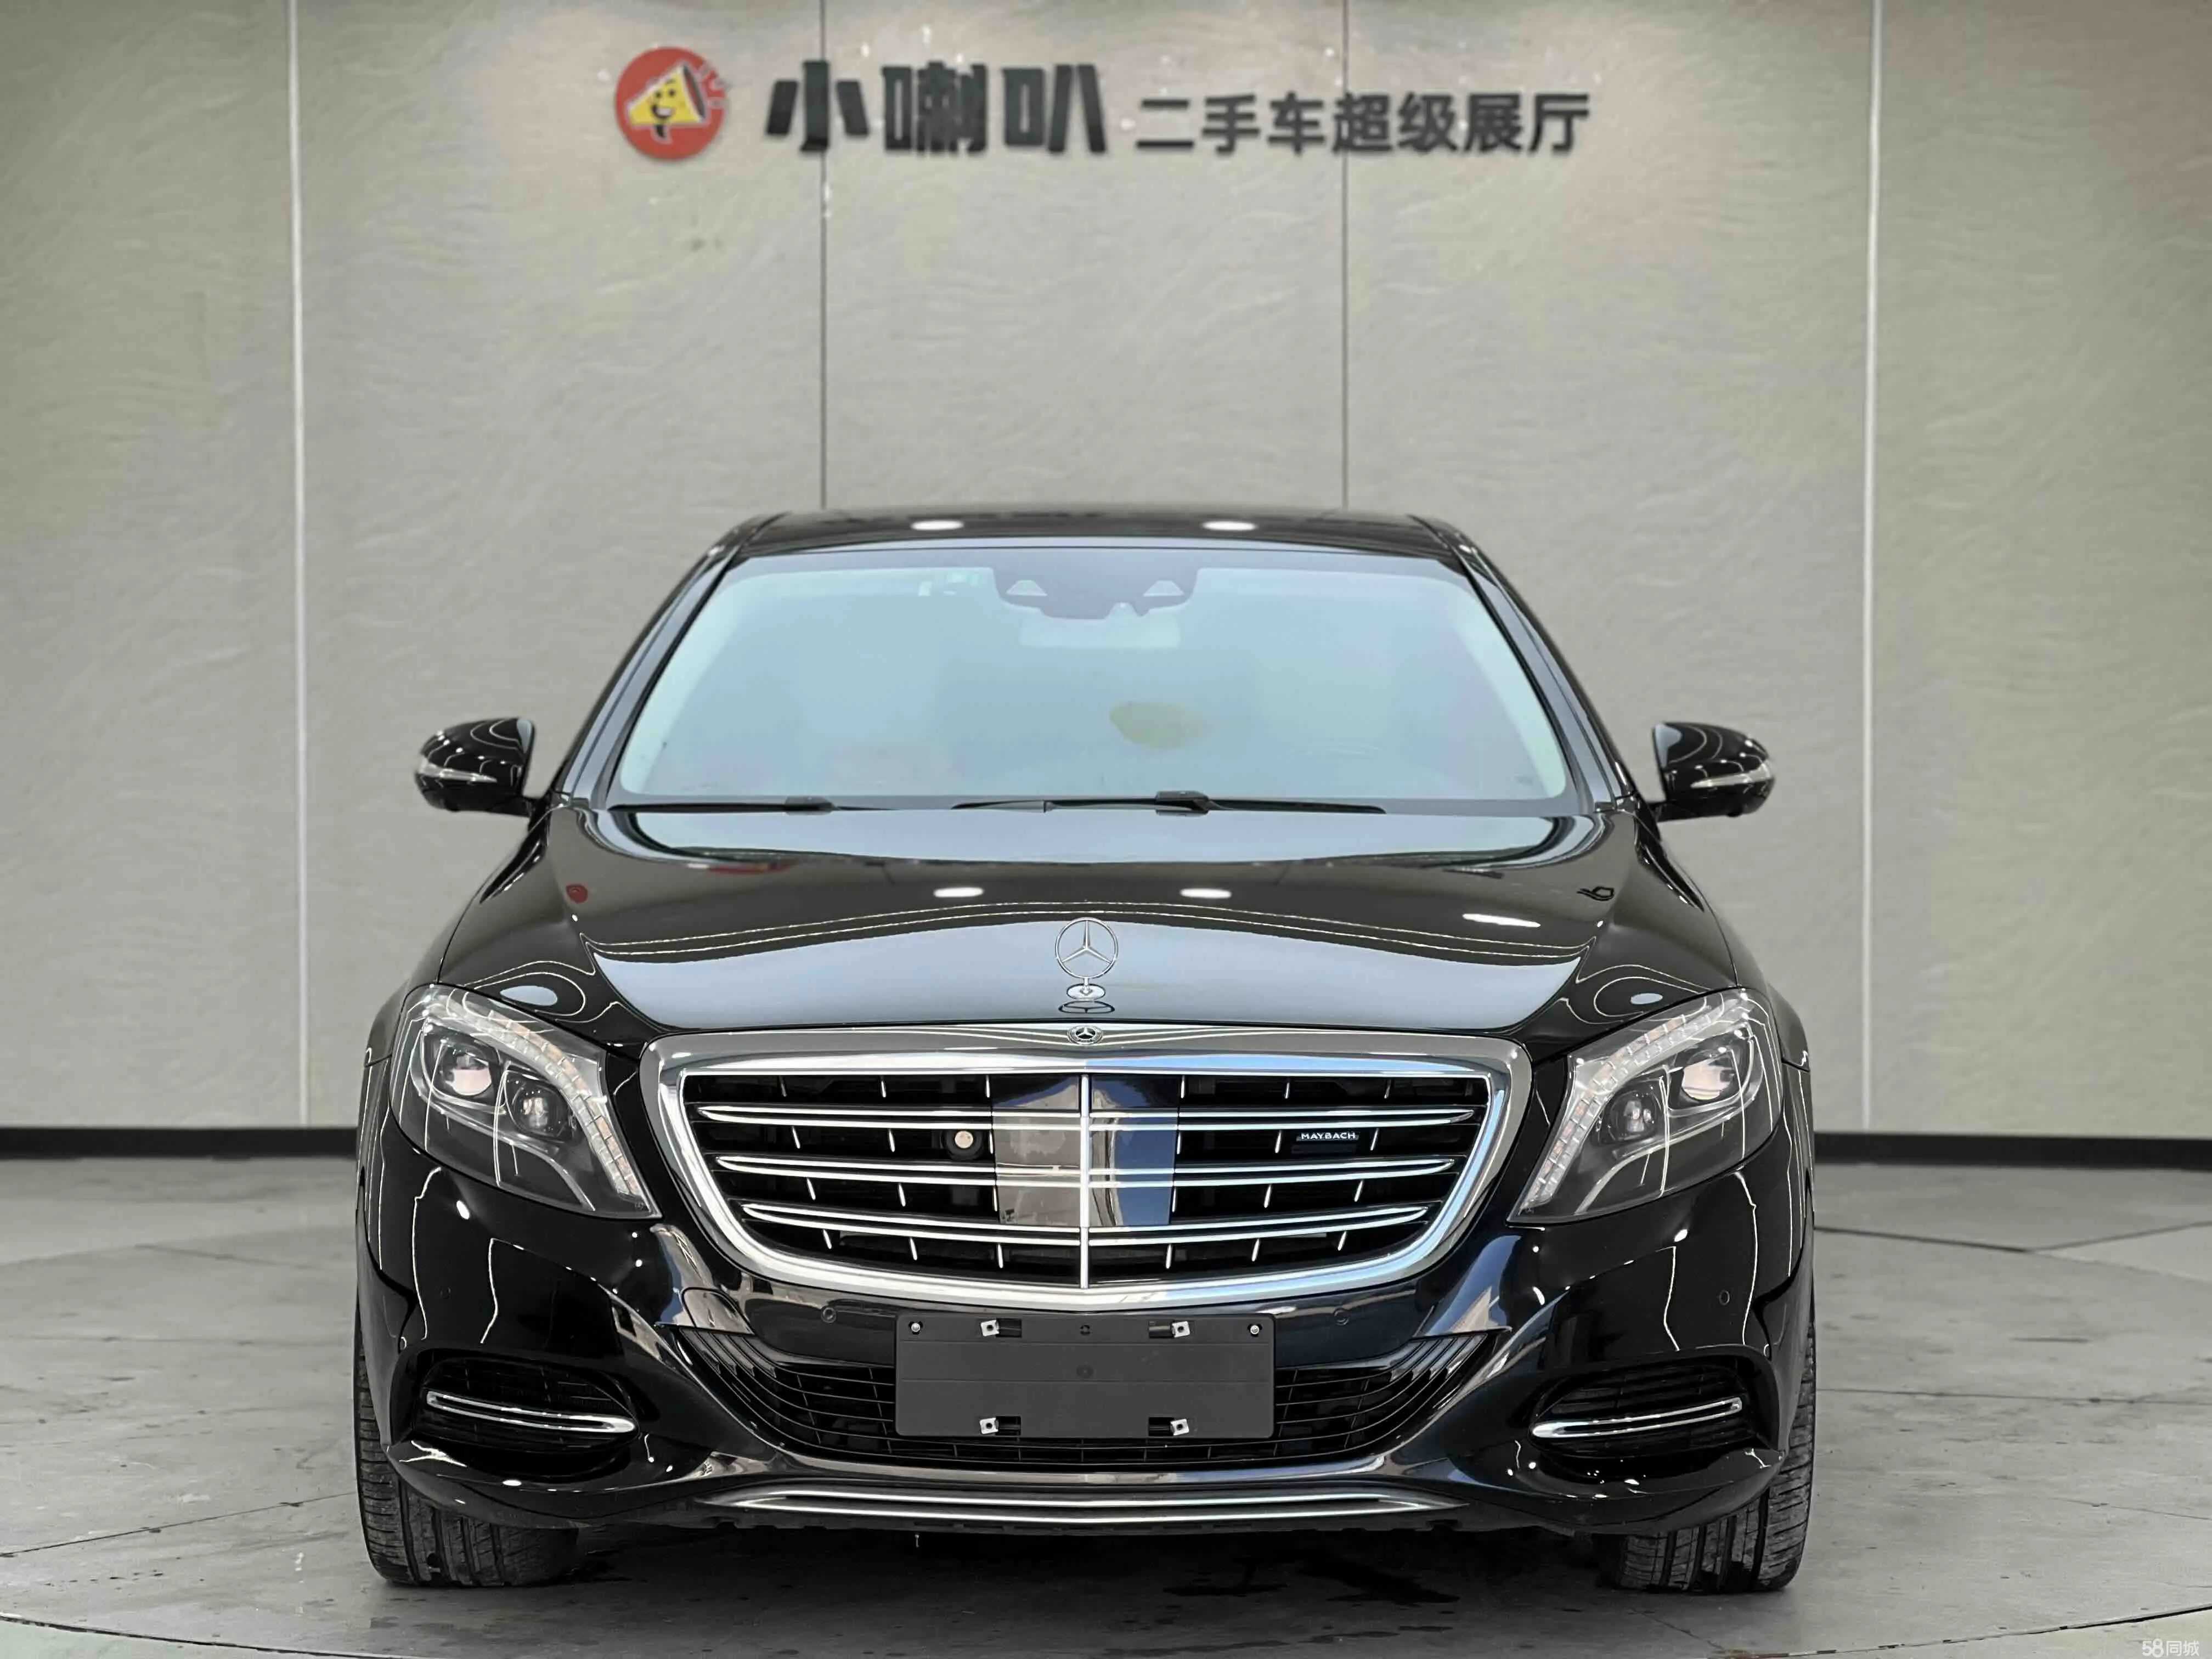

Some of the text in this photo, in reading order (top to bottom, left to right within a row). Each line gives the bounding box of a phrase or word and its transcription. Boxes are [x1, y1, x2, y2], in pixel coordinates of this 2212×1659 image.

[765, 60, 1590, 155] 小喇叭 二手车超级展厅
[1301, 1132, 1356, 1140] MAYBACH
